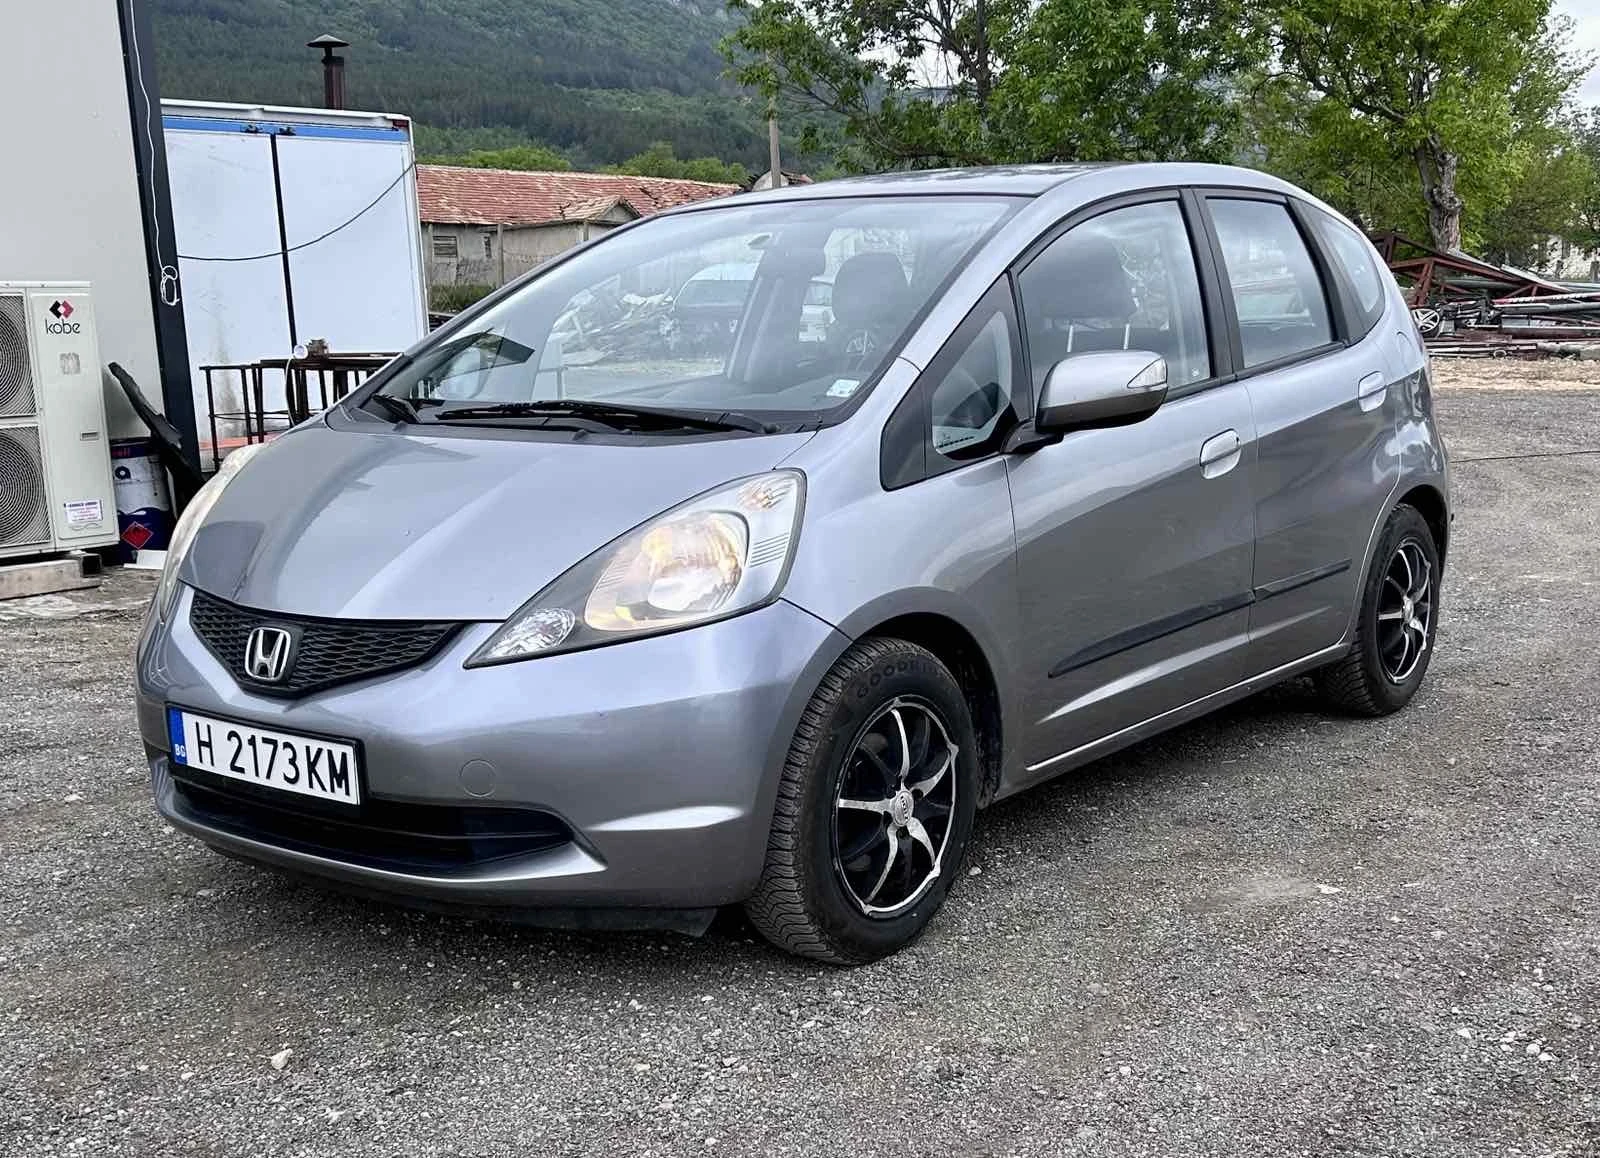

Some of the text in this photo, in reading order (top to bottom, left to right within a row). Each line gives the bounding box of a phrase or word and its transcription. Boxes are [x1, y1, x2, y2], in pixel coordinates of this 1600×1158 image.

[45, 317, 81, 335] kobe
[174, 743, 187, 758] BG
[195, 721, 215, 767] H
